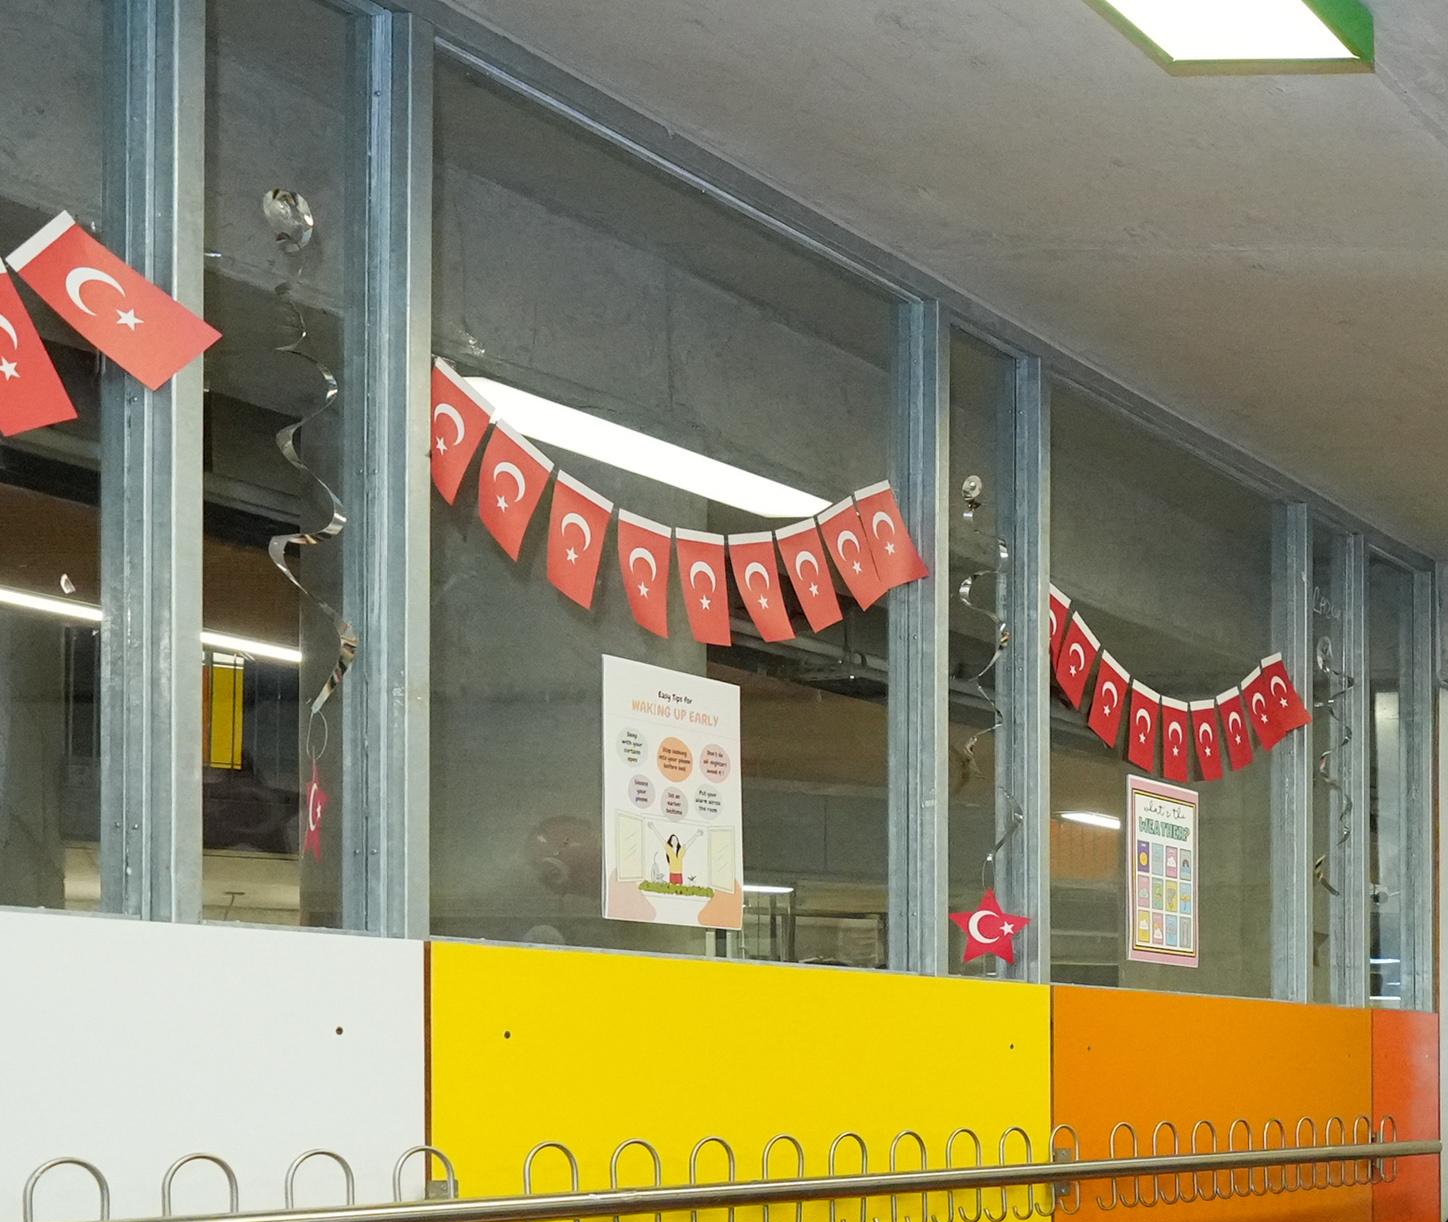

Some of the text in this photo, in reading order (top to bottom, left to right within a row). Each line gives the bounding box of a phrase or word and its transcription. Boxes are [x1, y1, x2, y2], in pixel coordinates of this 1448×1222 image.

[658, 691, 693, 704] Easy Tips for
[631, 699, 719, 727] WAKING UP EARLY
